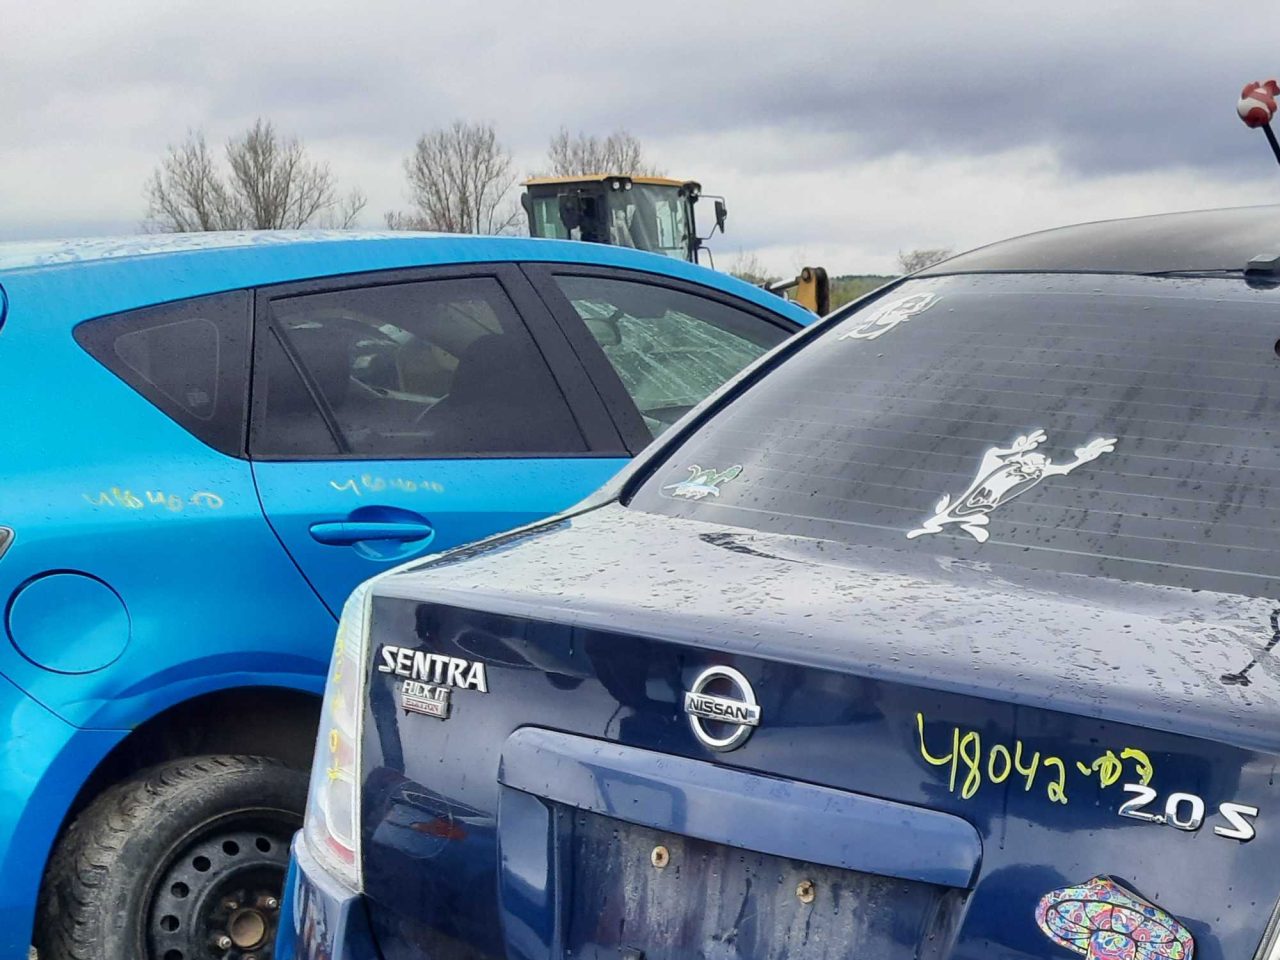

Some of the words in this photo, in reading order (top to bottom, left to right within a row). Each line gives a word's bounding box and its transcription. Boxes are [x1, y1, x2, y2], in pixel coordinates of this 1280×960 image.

[378, 645, 488, 693] SENTRA
[402, 680, 432, 699] FUCK
[434, 686, 450, 701] IT
[689, 697, 748, 721] NISSAN
[1118, 783, 1205, 832] 2.0
[1214, 802, 1259, 840] S
